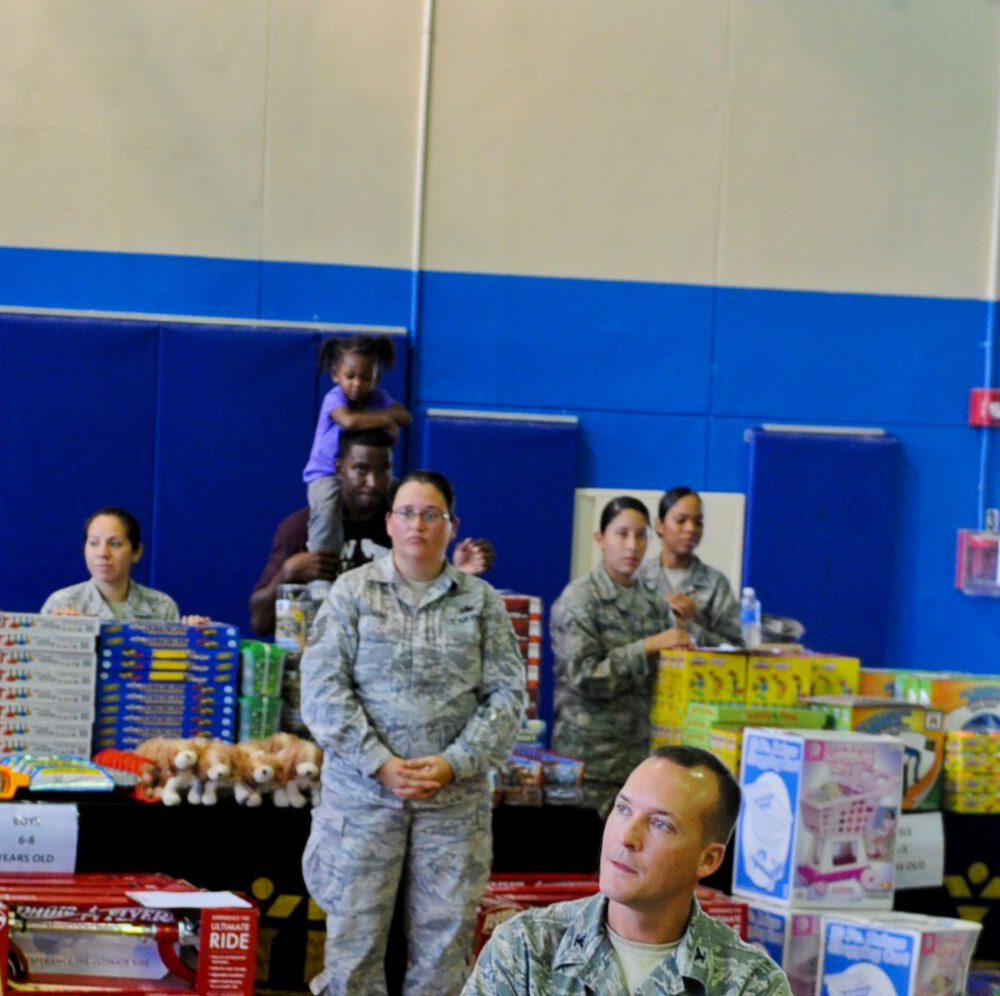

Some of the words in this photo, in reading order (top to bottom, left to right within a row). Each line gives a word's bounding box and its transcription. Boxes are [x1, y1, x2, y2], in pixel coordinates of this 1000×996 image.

[18, 836, 35, 845] 6-8
[33, 854, 54, 863] OLD
[105, 907, 175, 922] FLYER
[210, 922, 250, 931] ULTIMATE
[209, 931, 250, 949] RIDE
